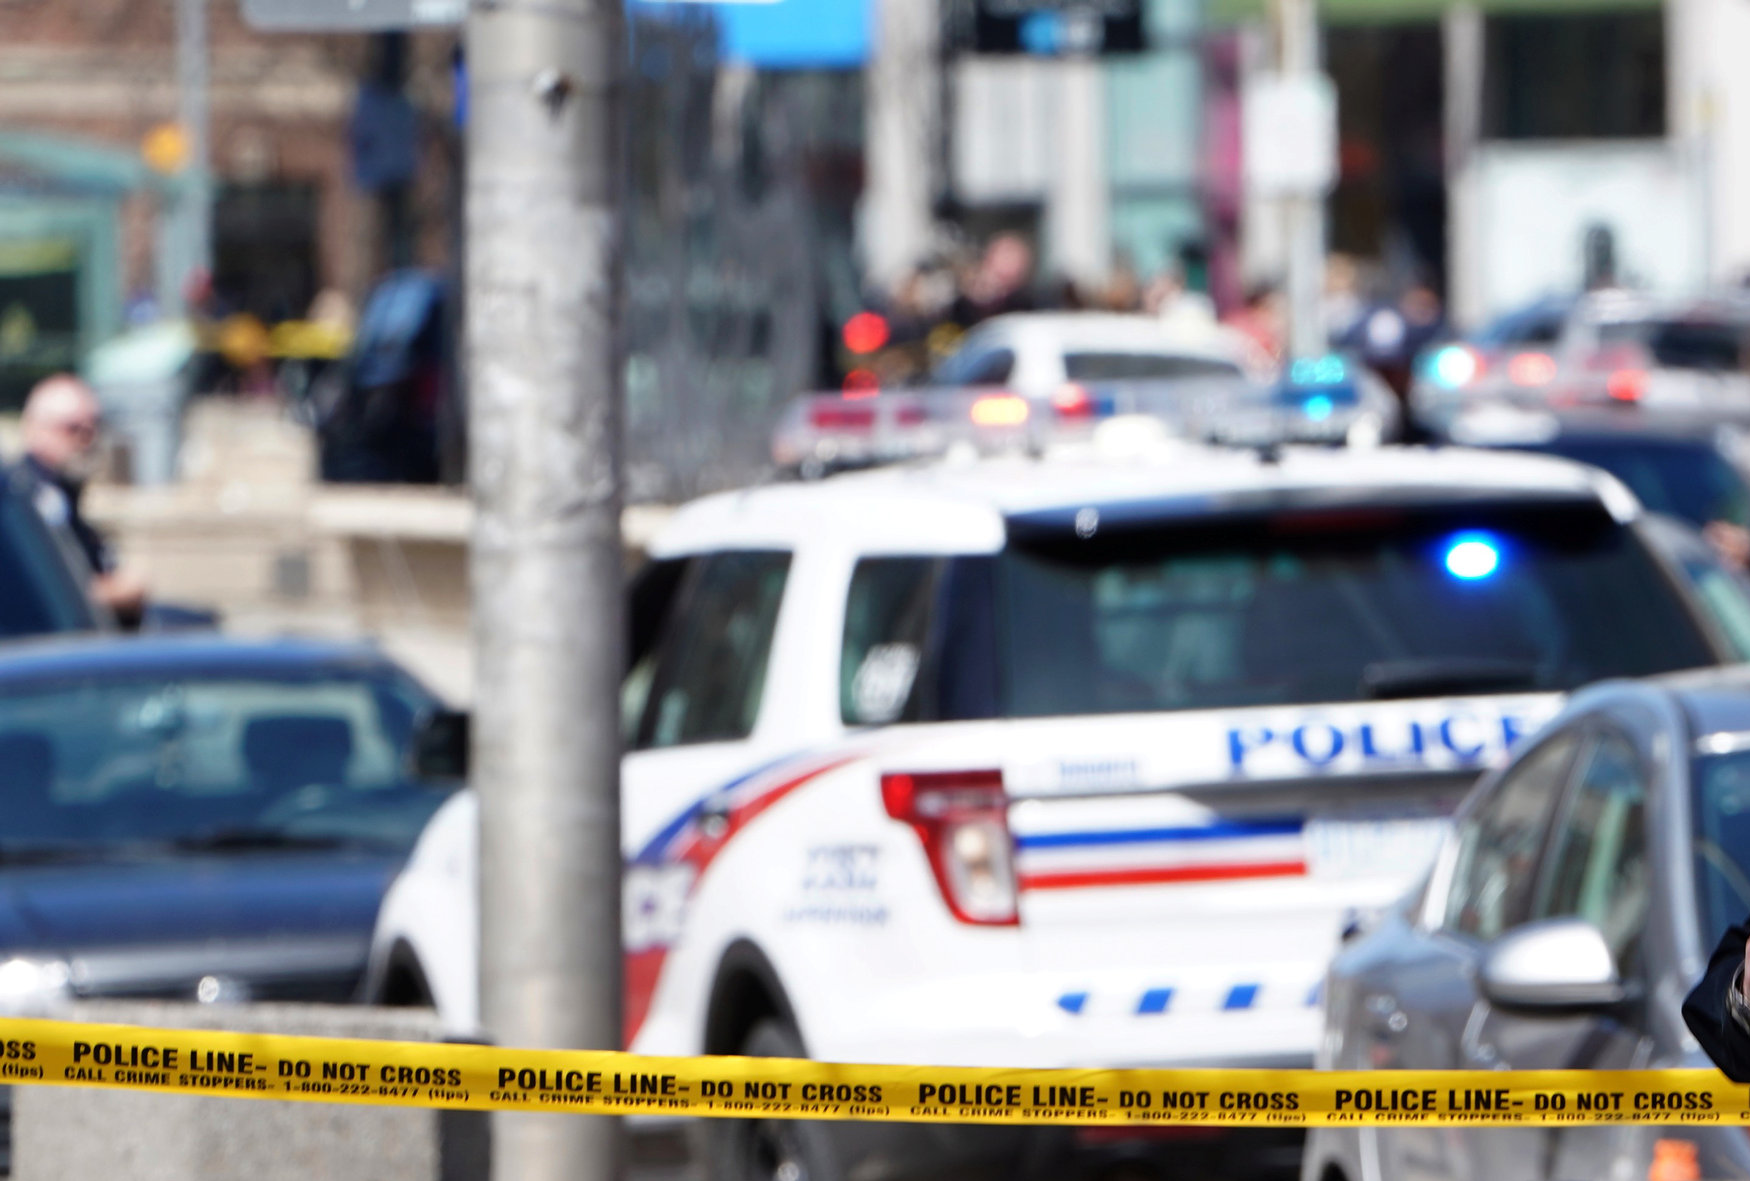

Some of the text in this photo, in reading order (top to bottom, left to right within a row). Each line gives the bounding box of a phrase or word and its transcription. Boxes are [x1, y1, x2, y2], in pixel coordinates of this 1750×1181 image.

[2, 1063, 43, 1079] (tips)
[73, 1041, 178, 1069] POLICE
[278, 1060, 311, 1077] DO
[323, 1062, 370, 1081] NOT
[381, 1066, 461, 1086] CROSS
[64, 1067, 106, 1081] CALL
[114, 1070, 170, 1086] CRIME
[499, 1068, 601, 1092] POLICE
[701, 1080, 733, 1097] DO
[745, 1082, 792, 1100] NOT
[802, 1084, 882, 1103] CROSS
[919, 1084, 1021, 1106] POLICE
[1120, 1091, 1151, 1108] DO
[1163, 1091, 1209, 1109] NOT
[1219, 1091, 1299, 1110] CROSS
[1335, 1089, 1437, 1111] POLICE
[1534, 1093, 1566, 1110] DO
[1577, 1092, 1624, 1110] NOT
[1634, 1091, 1713, 1110] CROSS
